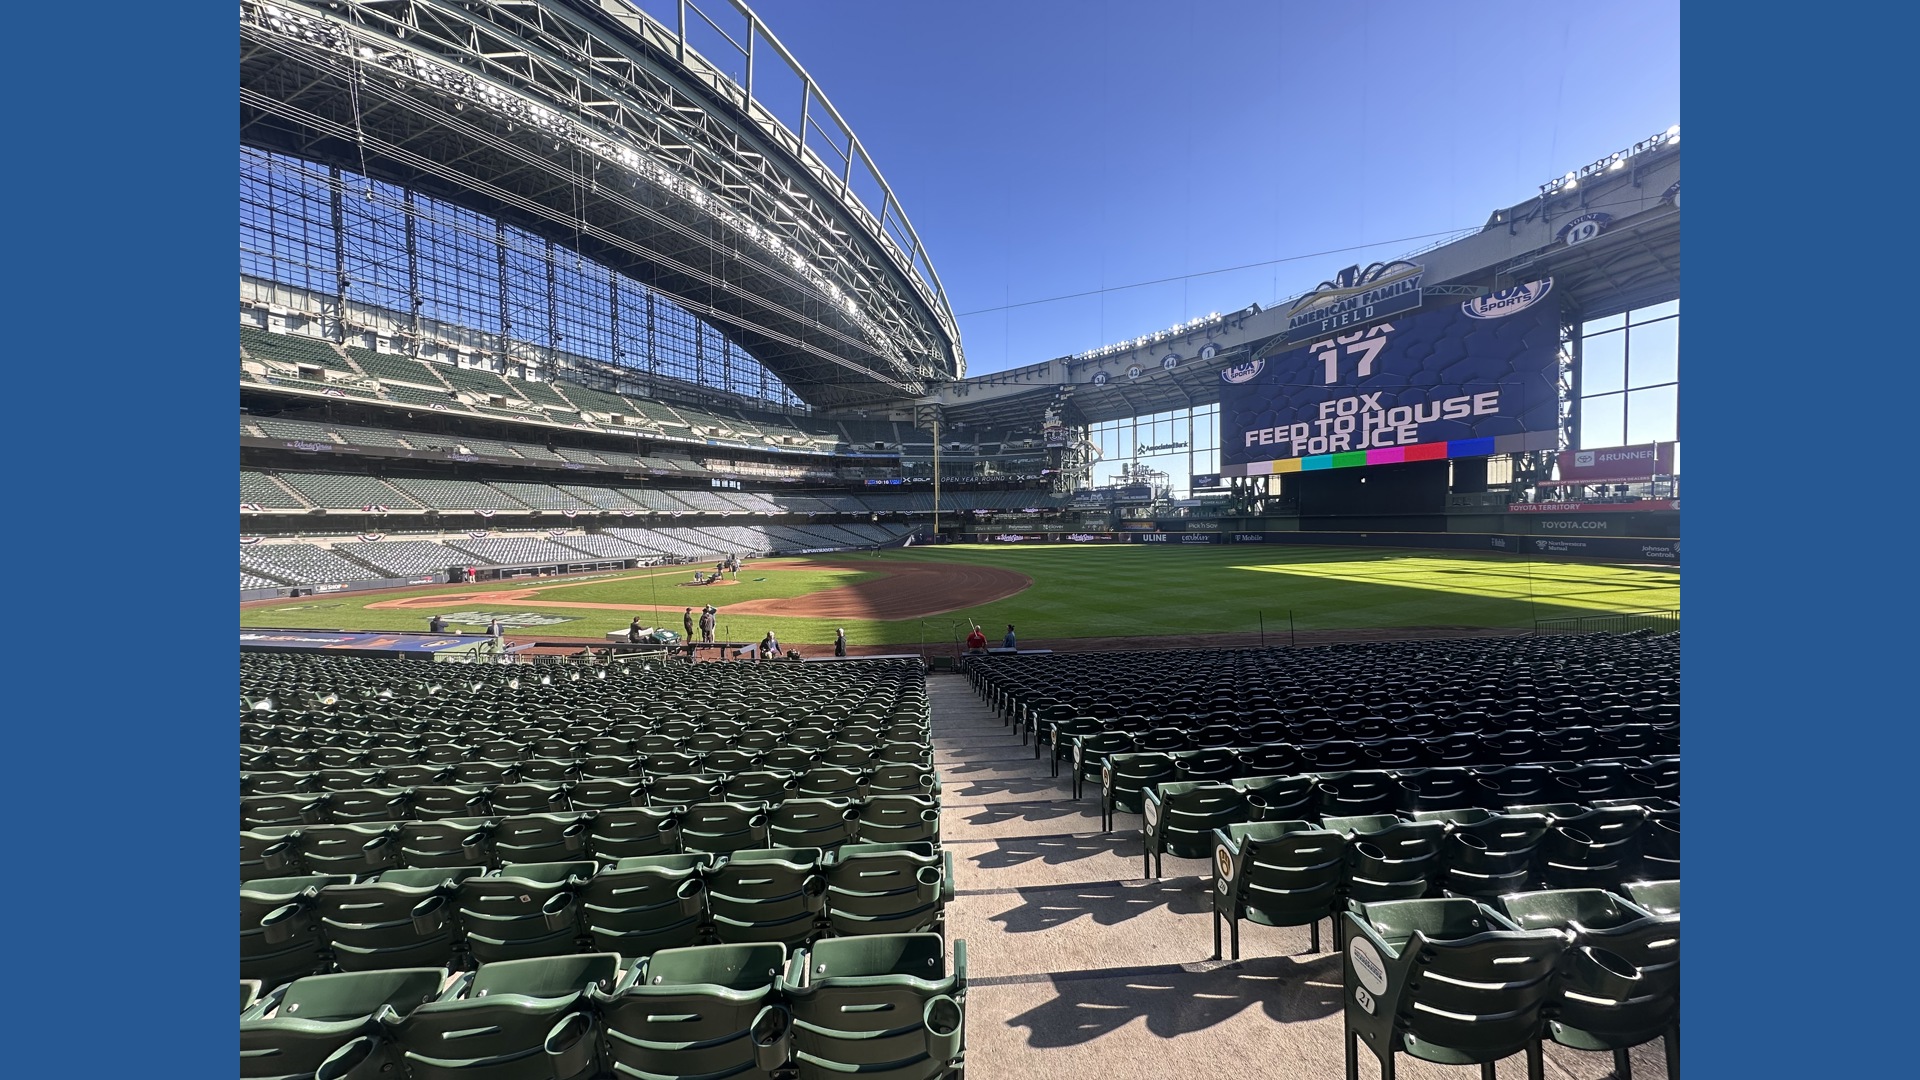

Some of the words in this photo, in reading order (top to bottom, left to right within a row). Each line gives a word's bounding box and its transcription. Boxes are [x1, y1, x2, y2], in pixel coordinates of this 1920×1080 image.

[1567, 213, 1598, 228] YOUNT
[1571, 223, 1594, 243] 19
[1288, 298, 1357, 329] AMERICAN
[1362, 276, 1422, 305] FAMILY
[1479, 295, 1532, 314] SPORTS
[1321, 305, 1374, 332] FIELD
[1318, 335, 1387, 385] 17
[1230, 368, 1256, 380] SPORTS
[1319, 391, 1383, 420] FOX
[1245, 422, 1309, 447] FEED
[1314, 415, 1356, 437] TO
[1362, 390, 1500, 431] HOUSE
[1291, 433, 1351, 457] FOR
[1355, 423, 1419, 450] JCE
[1598, 450, 1655, 462] 4RUNNER
[1509, 504, 1538, 512] TOYOTA
[1538, 503, 1581, 511] TERRITORY
[1541, 520, 1608, 530] TOYOTA.COM
[1142, 533, 1167, 542] ULINE
[1358, 991, 1371, 1009] 21
